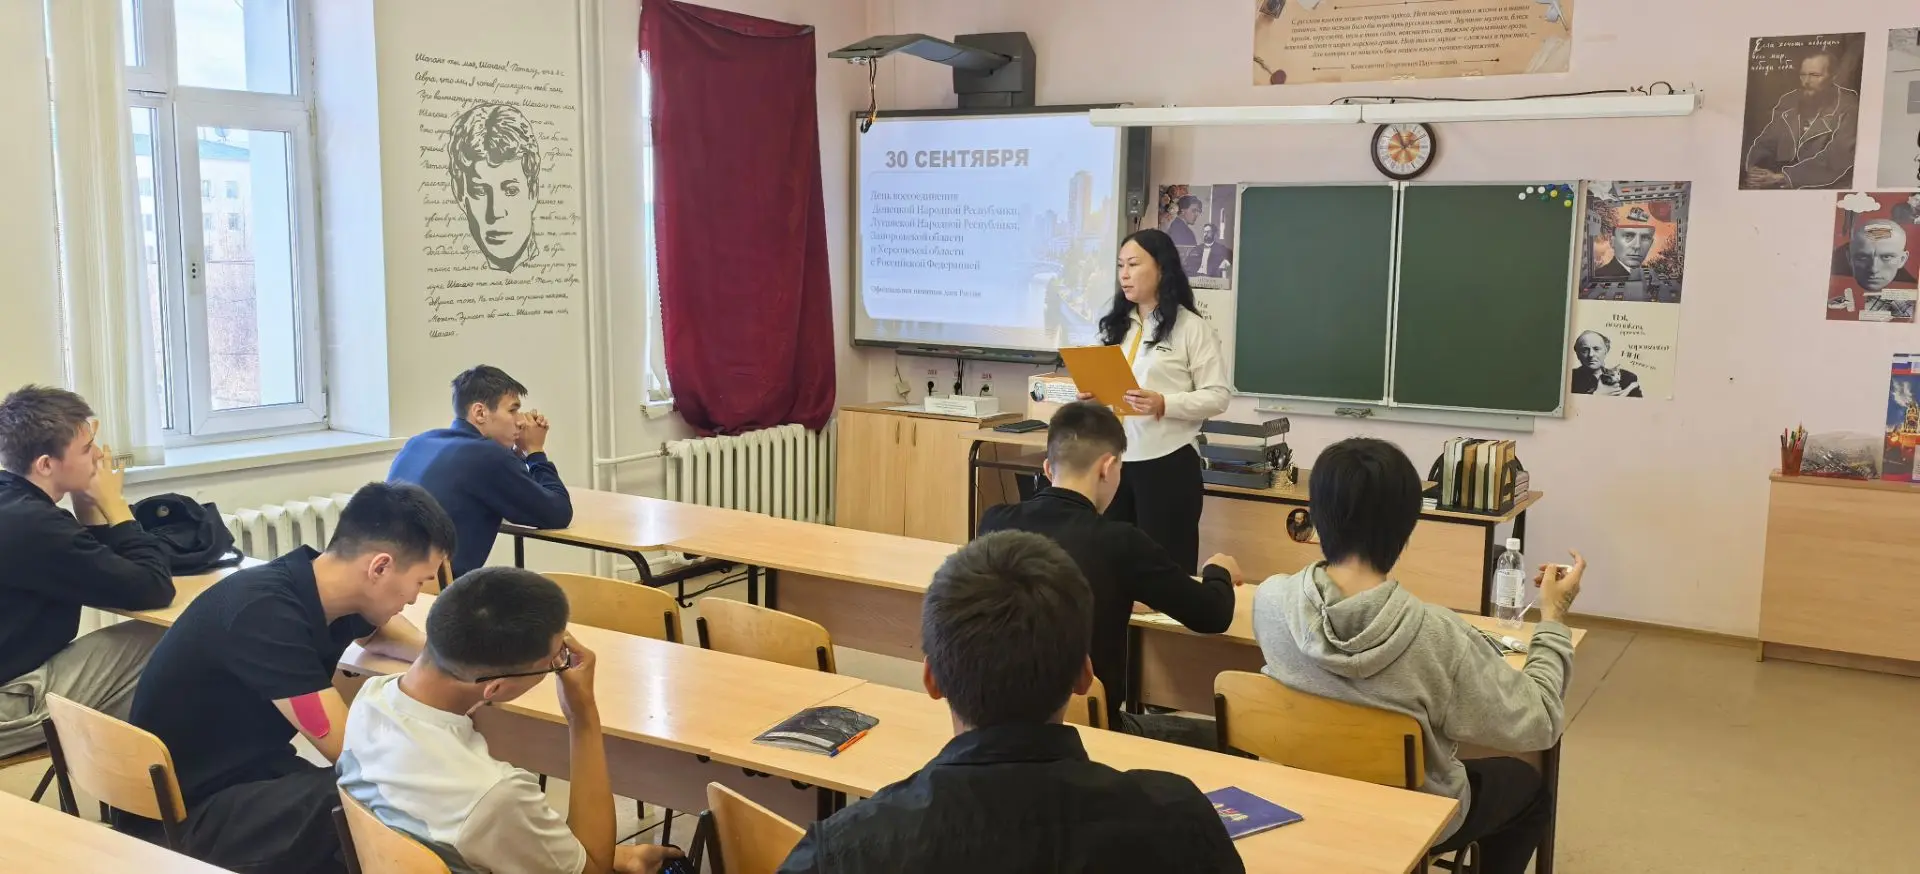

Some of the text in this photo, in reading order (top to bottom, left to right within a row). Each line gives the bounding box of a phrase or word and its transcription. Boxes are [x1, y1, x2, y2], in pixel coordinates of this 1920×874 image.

[886, 148, 1030, 168] 30 СЕНТЯБРЯ
[870, 190, 959, 201] День воссоединения
[872, 203, 914, 215] Донецкой
[917, 203, 961, 217] Народной
[870, 217, 914, 229] Луганской
[917, 217, 961, 230] Народной
[928, 231, 964, 242] области
[877, 244, 928, 256] Херсонской
[928, 245, 964, 256] области
[876, 257, 925, 268] Российской
[926, 259, 980, 271] Федерацией
